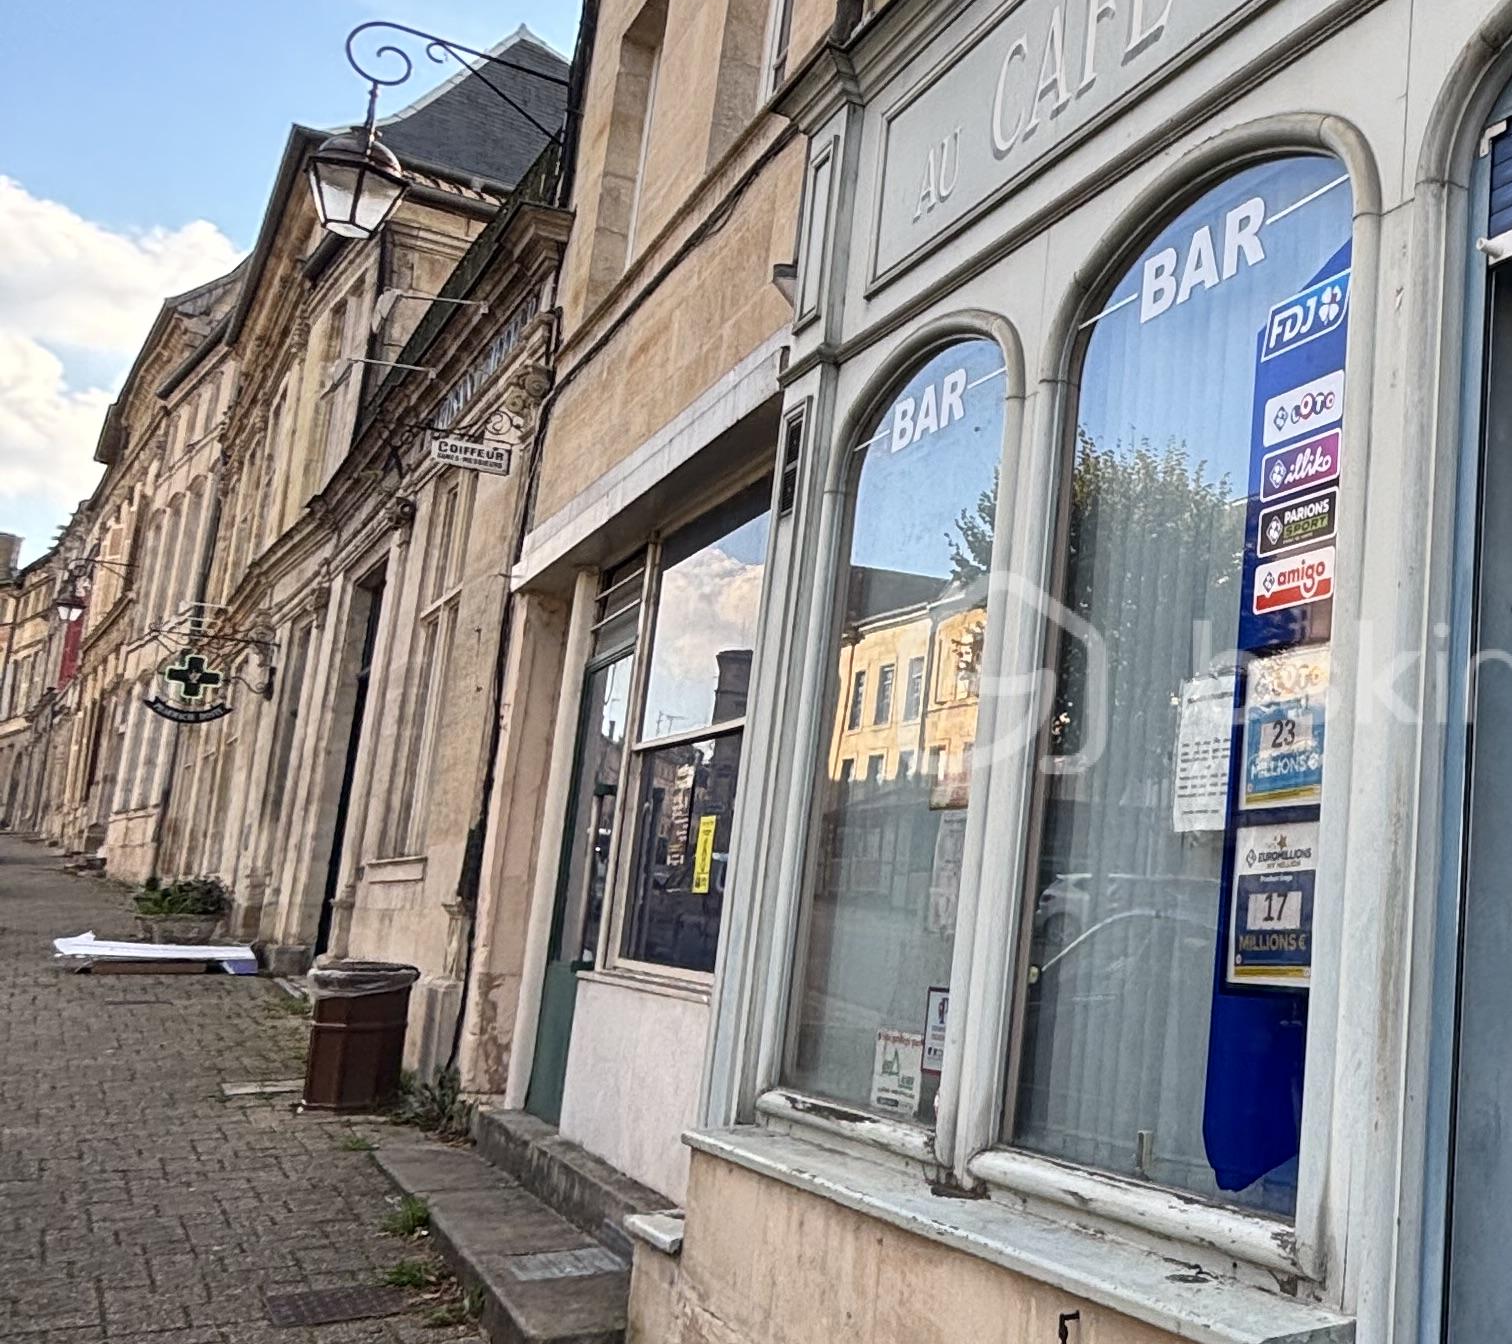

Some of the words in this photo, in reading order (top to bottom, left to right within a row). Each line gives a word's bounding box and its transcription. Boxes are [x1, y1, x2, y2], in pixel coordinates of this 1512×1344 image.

[911, 124, 963, 224] AU
[1139, 196, 1266, 324] BAR
[1269, 295, 1318, 349] FDJ
[890, 367, 968, 455] BAR
[1290, 391, 1336, 425] LOTO
[438, 440, 504, 462] COIFFEUR
[1283, 445, 1333, 485] illiko
[1284, 498, 1330, 524] PARIONS
[1285, 516, 1327, 538] SPORT
[1277, 559, 1326, 594] amigo
[1271, 719, 1297, 749] 23
[1250, 755, 1307, 780] MILLIONS
[1257, 847, 1313, 864] EUROMILLIONS
[1263, 892, 1289, 923] 17
[1238, 932, 1297, 952] MILLIONS
[1299, 935, 1308, 951] €
